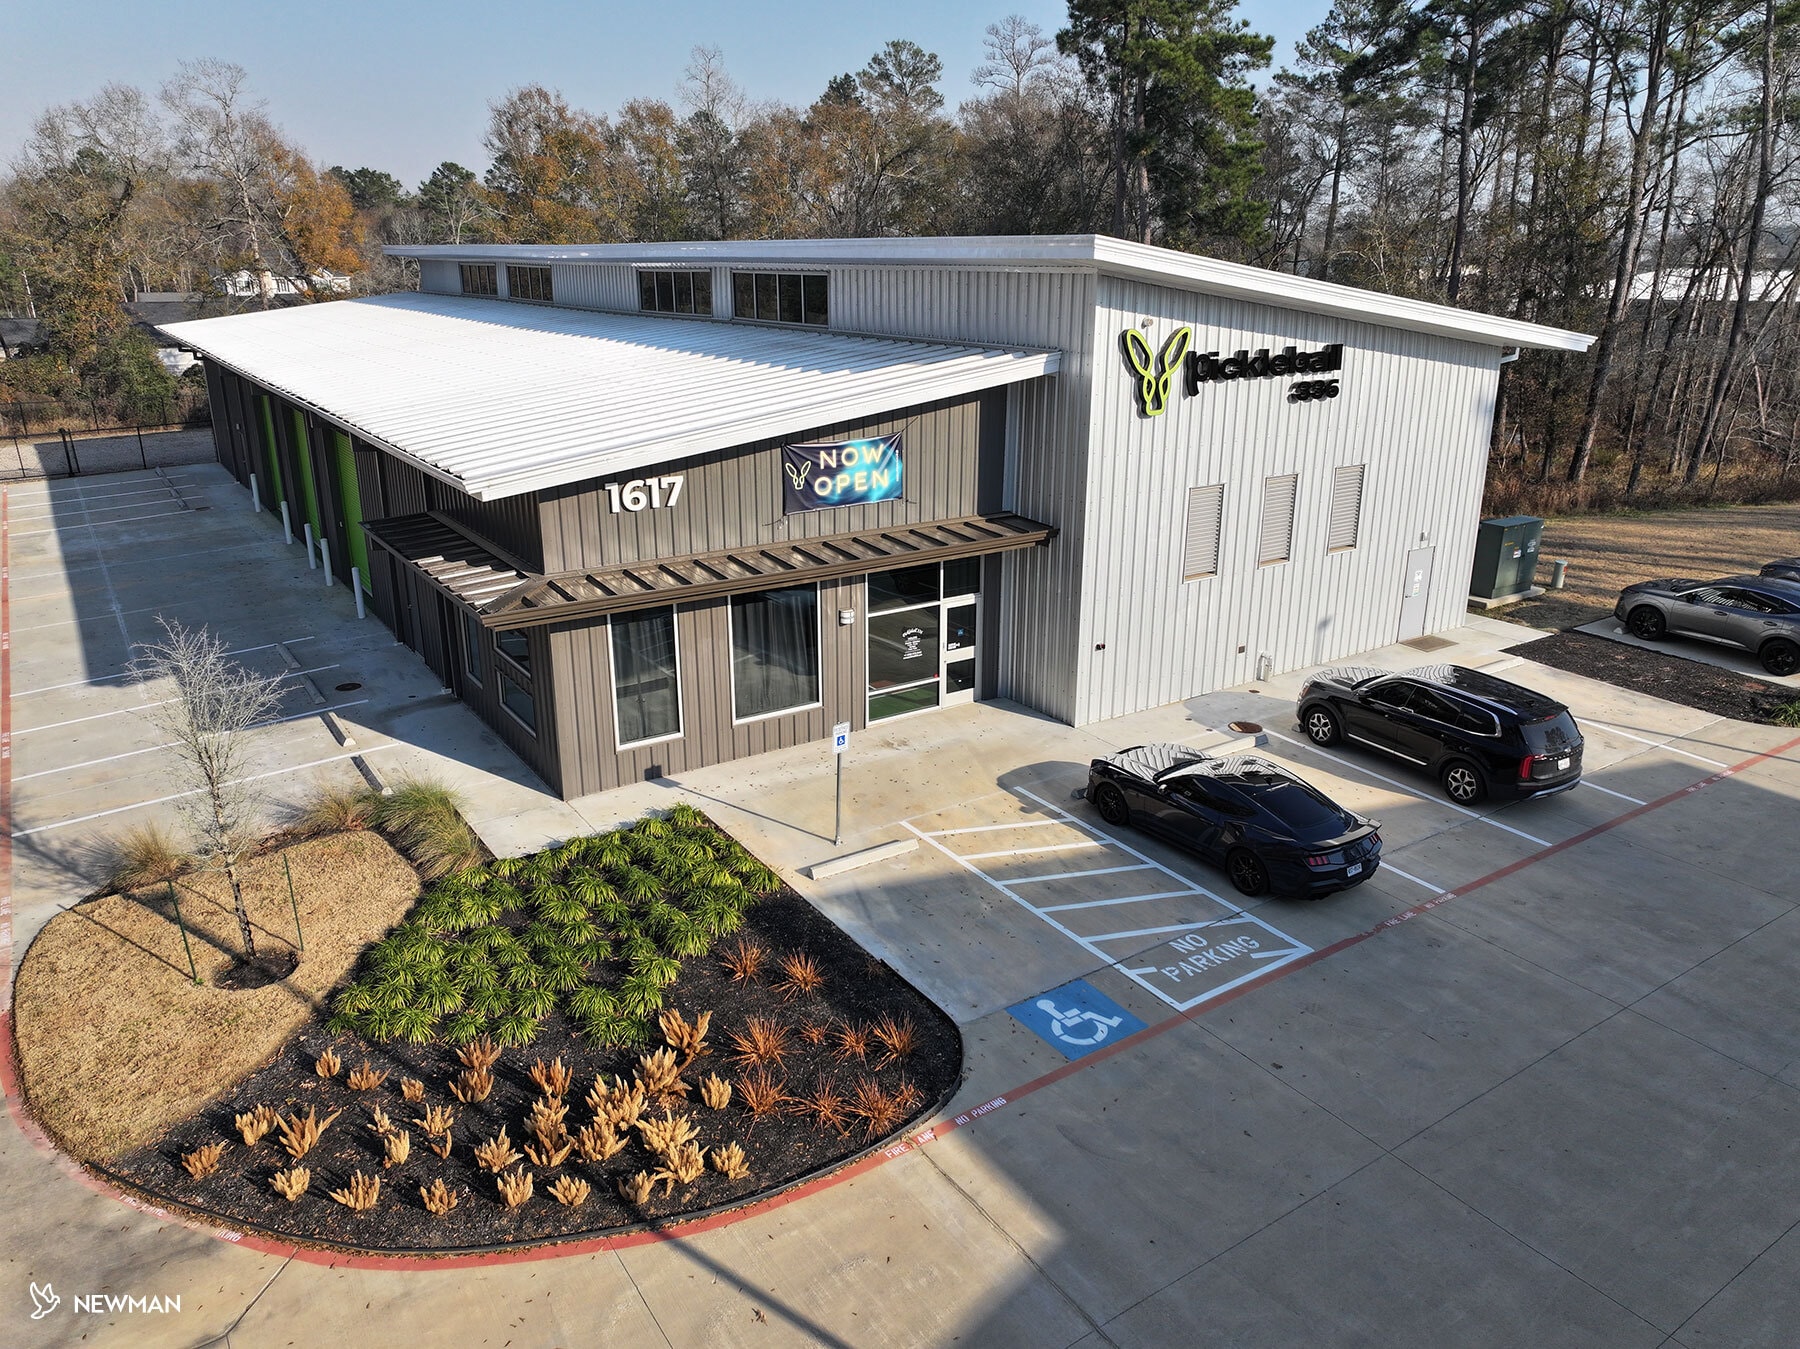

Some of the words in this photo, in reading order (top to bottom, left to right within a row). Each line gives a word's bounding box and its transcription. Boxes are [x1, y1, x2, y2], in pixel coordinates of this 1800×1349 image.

[1186, 344, 1343, 397] pickleball
[819, 443, 884, 470] NOW
[604, 475, 685, 514] 1617
[814, 468, 889, 497] OPEN
[1160, 935, 1260, 983] PARKING
[1168, 934, 1208, 954] NO
[884, 1143, 909, 1159] FIRE
[954, 1114, 970, 1126] NO
[970, 1096, 1007, 1118] PARKING
